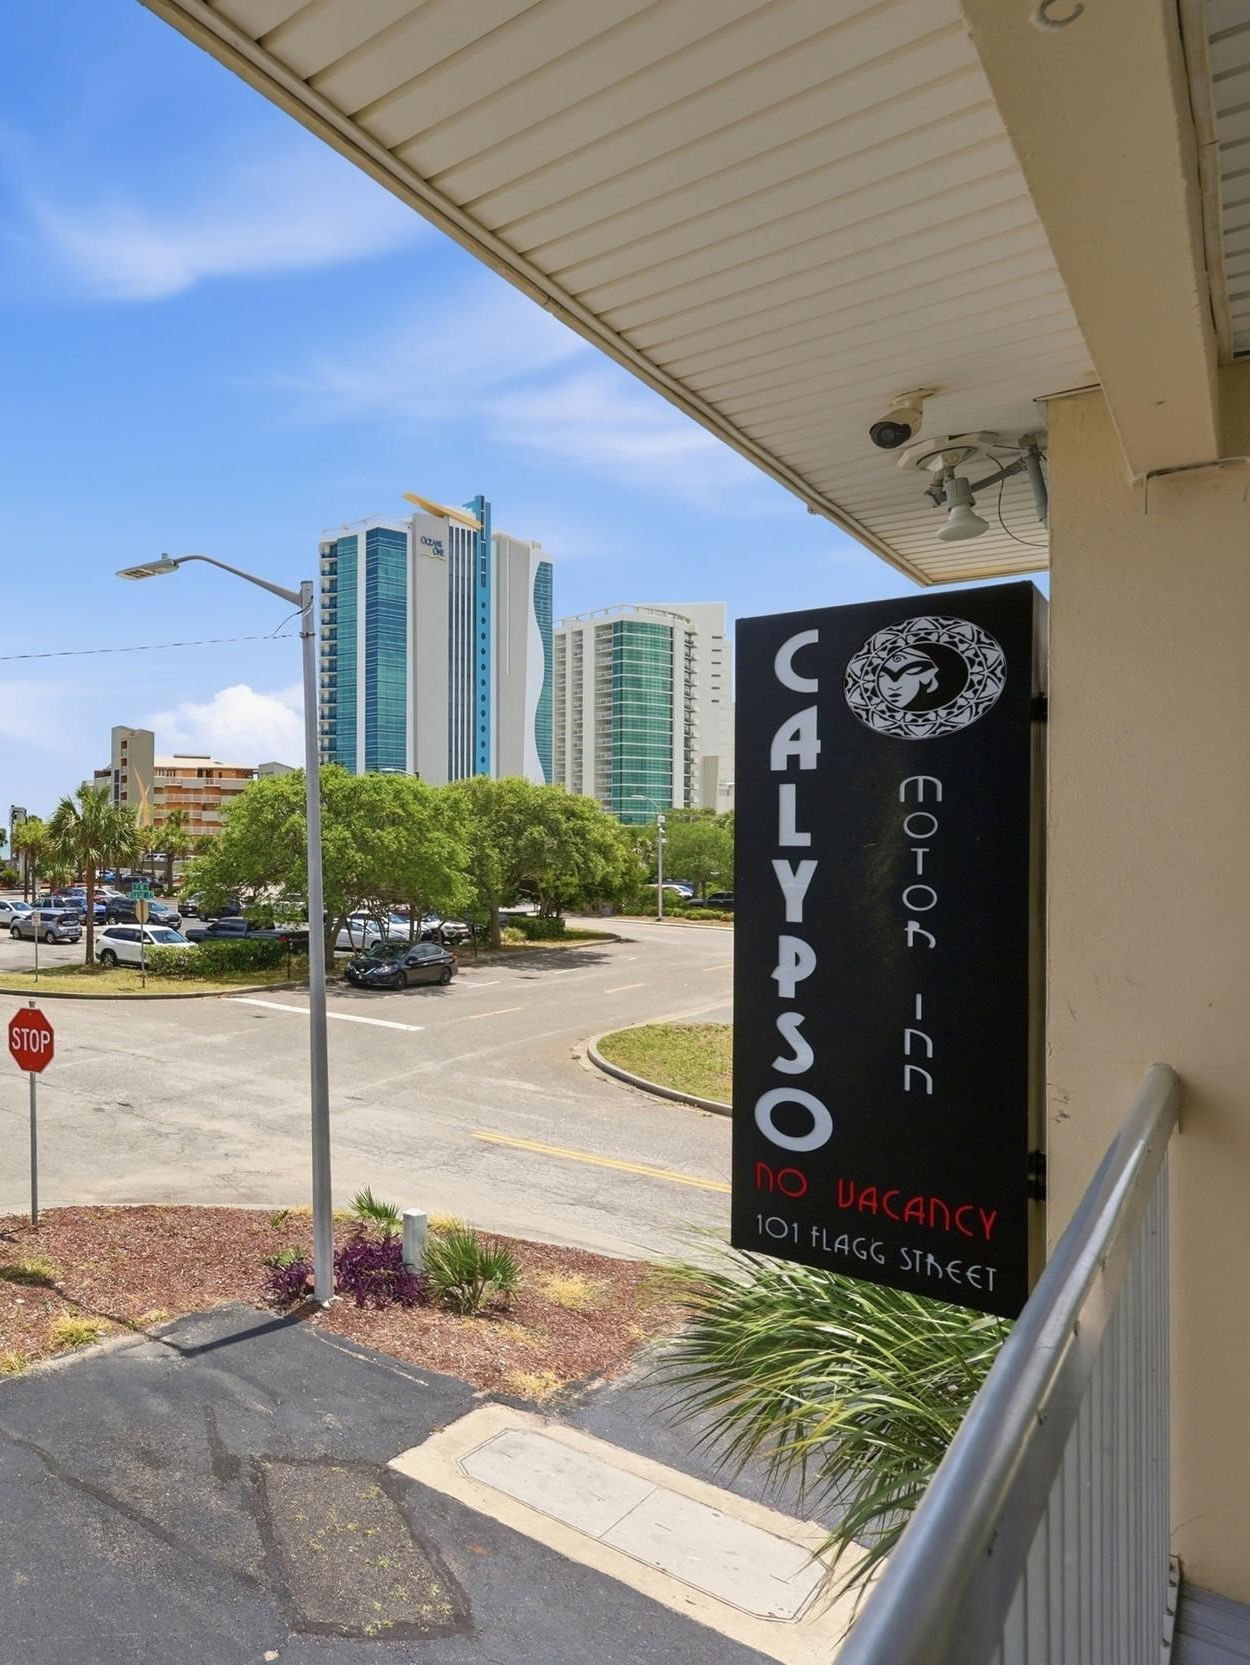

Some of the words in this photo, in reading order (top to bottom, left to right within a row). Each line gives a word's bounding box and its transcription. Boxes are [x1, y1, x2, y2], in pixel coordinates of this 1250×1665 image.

[754, 629, 834, 1152] CALYPSO
[899, 775, 943, 949] MOTOR
[11, 1027, 50, 1053] STOP
[903, 993, 934, 1095] INN
[755, 1161, 808, 1198] NO
[837, 1178, 998, 1241] VACANCY
[756, 1213, 799, 1244] 101
[900, 1247, 998, 1292] STREET
